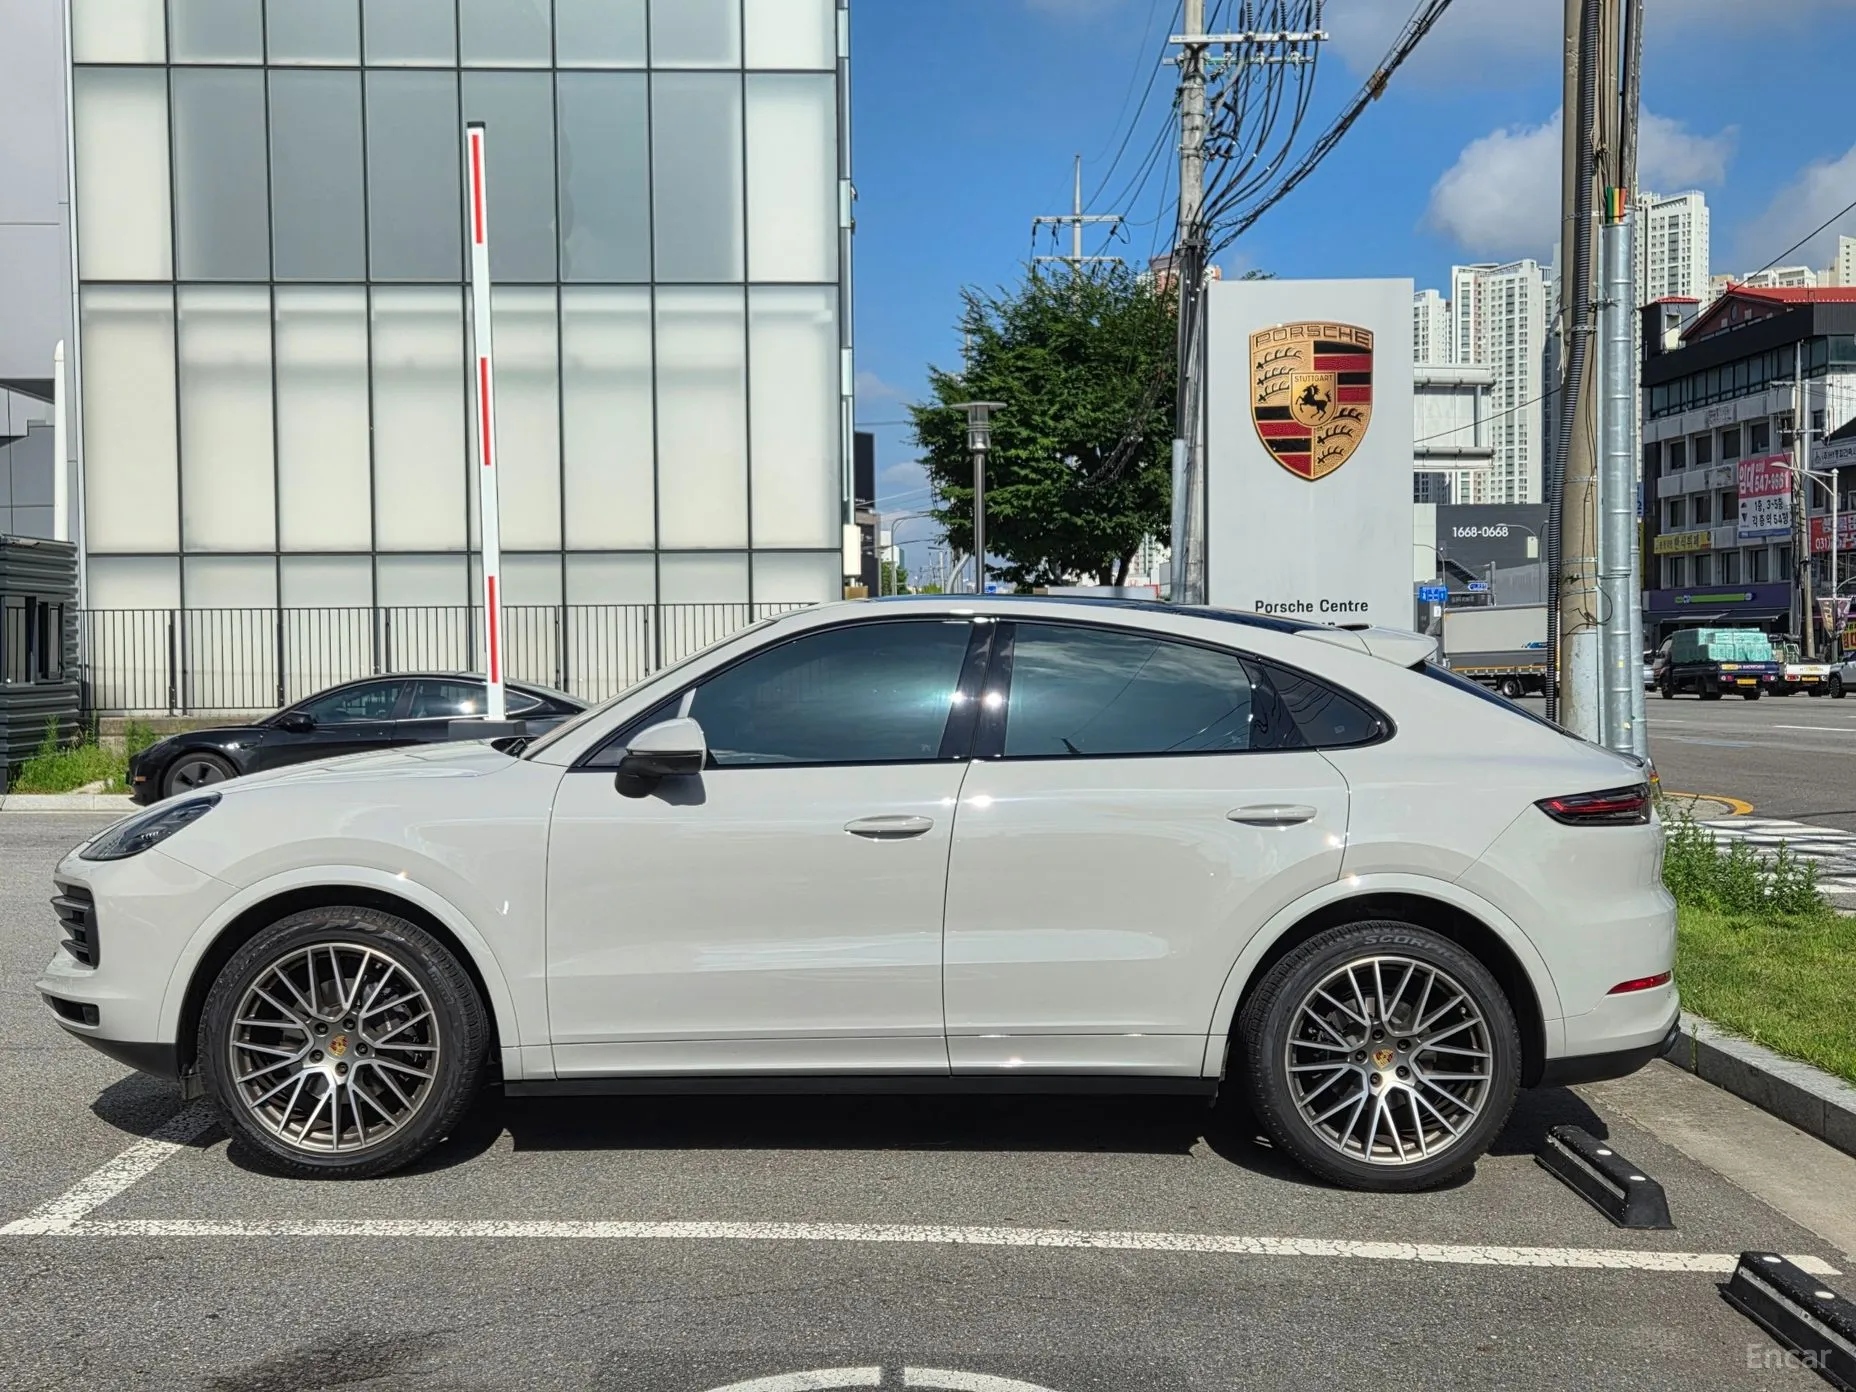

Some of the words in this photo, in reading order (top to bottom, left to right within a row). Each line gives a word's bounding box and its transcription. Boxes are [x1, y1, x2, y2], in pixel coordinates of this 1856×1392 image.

[1255, 325, 1370, 348] PORSCHE
[1452, 526, 1509, 538] 1668-0668
[1255, 599, 1314, 613] Porsche
[1319, 599, 1369, 612] Centre
